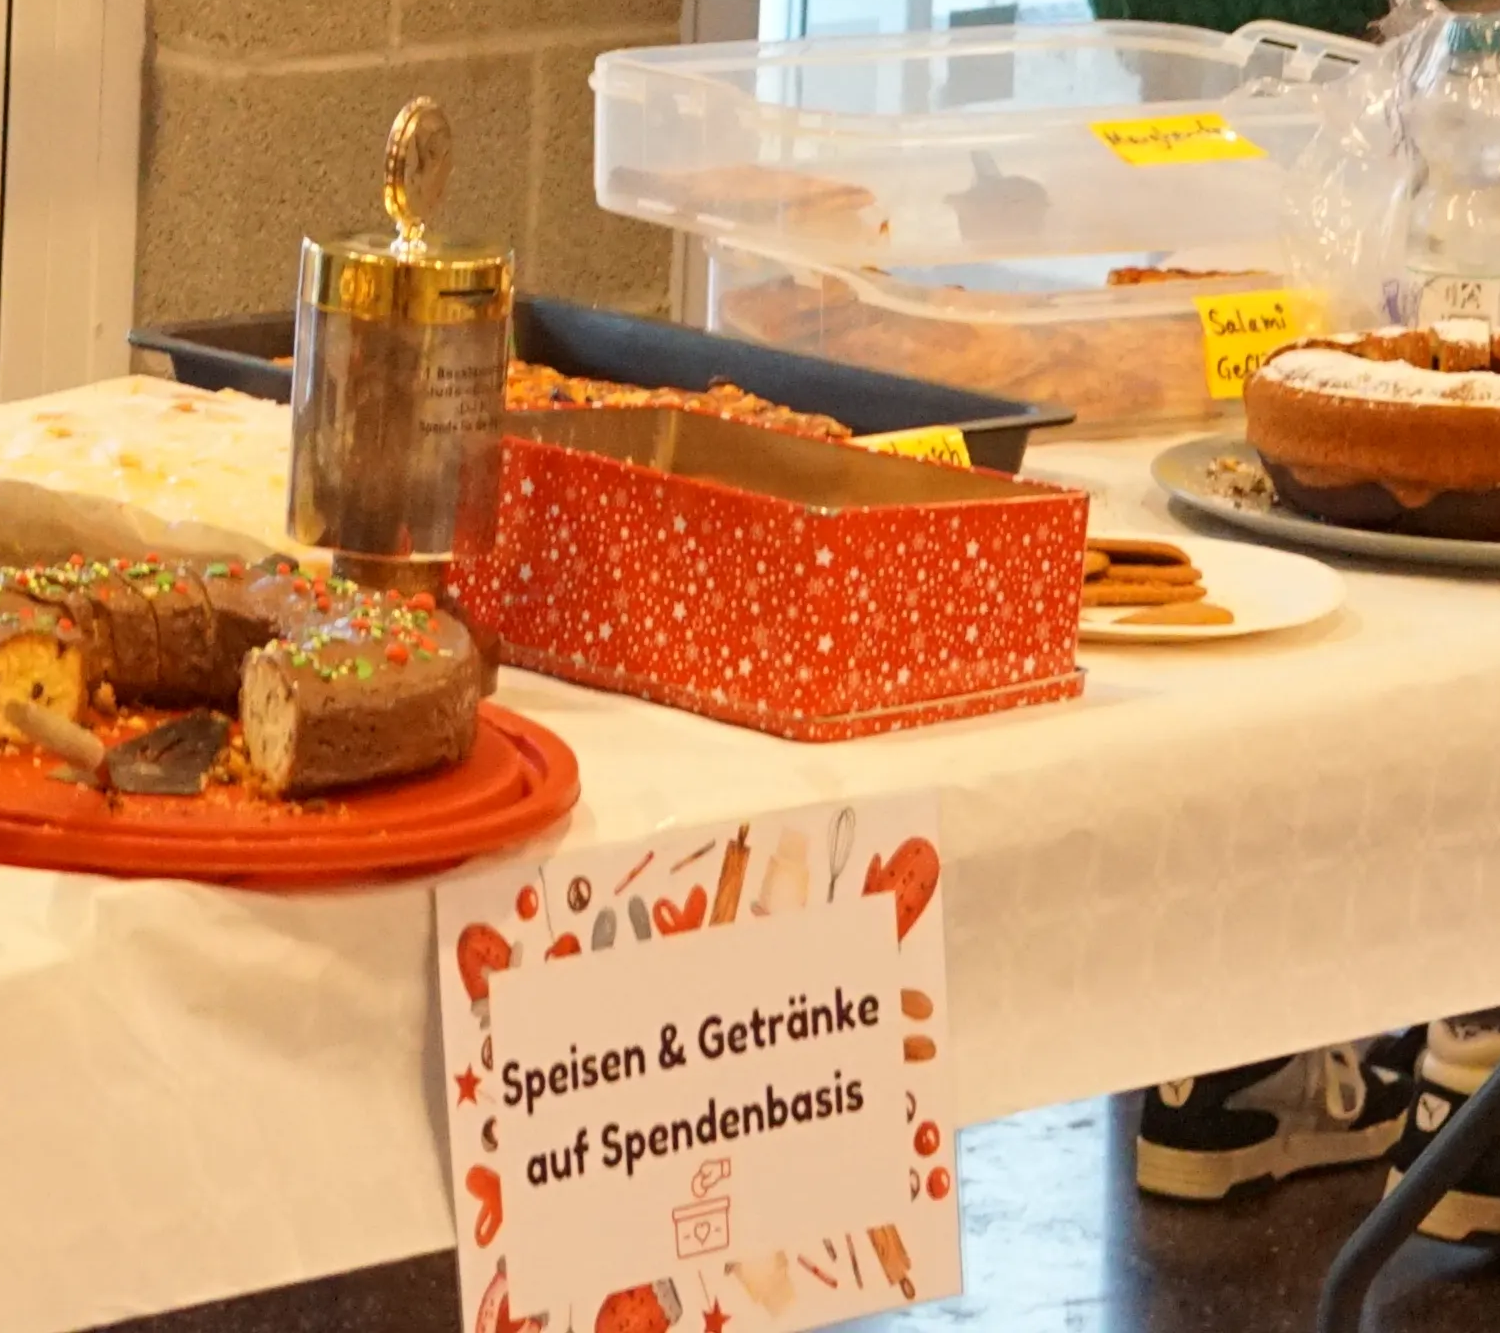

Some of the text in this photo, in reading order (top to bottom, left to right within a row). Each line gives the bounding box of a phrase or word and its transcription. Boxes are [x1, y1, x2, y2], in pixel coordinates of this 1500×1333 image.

[1208, 302, 1287, 336] Salami
[502, 987, 880, 1114] Speisen & Getränke
[526, 1071, 865, 1187] auf Spendenbasis
